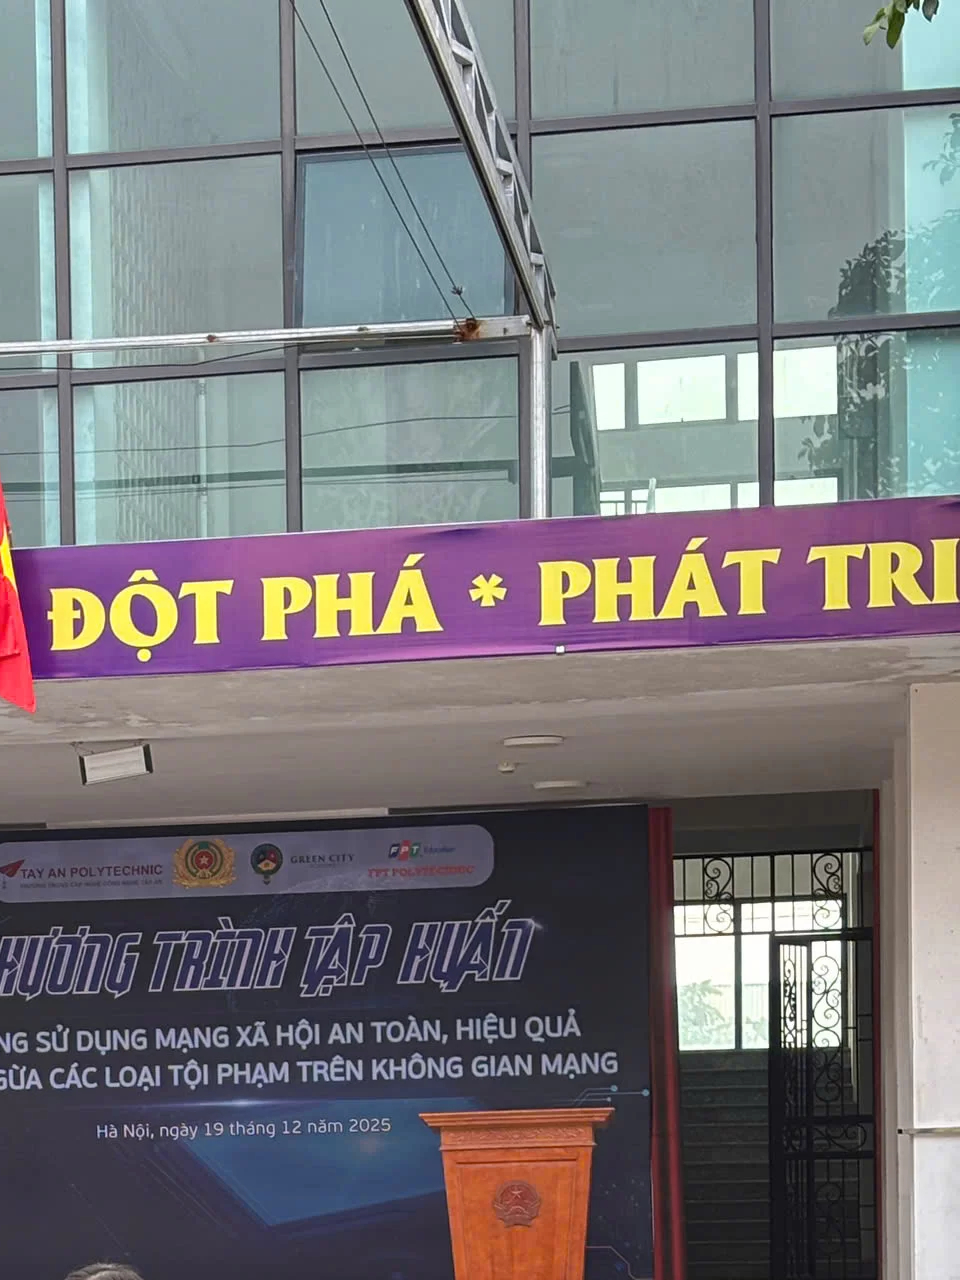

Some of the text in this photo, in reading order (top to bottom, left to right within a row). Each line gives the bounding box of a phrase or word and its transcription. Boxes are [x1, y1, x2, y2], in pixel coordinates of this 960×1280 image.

[47, 569, 234, 663] ĐỘT
[260, 552, 444, 642] PHÁ
[537, 536, 781, 626] PHÁT
[806, 538, 960, 611] TRI
[290, 853, 356, 864] GREEN CITY
[389, 840, 421, 861] FPT
[21, 863, 164, 879] TAY AN POLYTECHNIC
[148, 916, 298, 993] TRÌNH
[300, 912, 392, 997] TẬP
[35, 1024, 70, 1053] SỬ
[77, 1029, 148, 1056] DỤNG
[155, 1026, 230, 1053] MẠNG
[236, 1020, 270, 1047] XÃ
[276, 1018, 321, 1050] HỘI
[327, 1022, 364, 1045] AN
[370, 1015, 449, 1046] TOÀN,
[456, 1012, 518, 1044] HIỆU
[524, 1008, 582, 1042] QUẢ
[49, 1062, 98, 1089] CÁC
[104, 1065, 162, 1092] LOẠI
[167, 1058, 209, 1090] TỘI
[217, 1062, 290, 1088] PHẠM
[296, 1055, 364, 1083] TRÊN
[371, 1052, 464, 1080] KHÔNG
[470, 1055, 533, 1078] GIAN
[540, 1051, 620, 1079] MẠNG
[96, 1118, 392, 1141] Hà Nội, ngày 19 tháng 12 năm 2025
